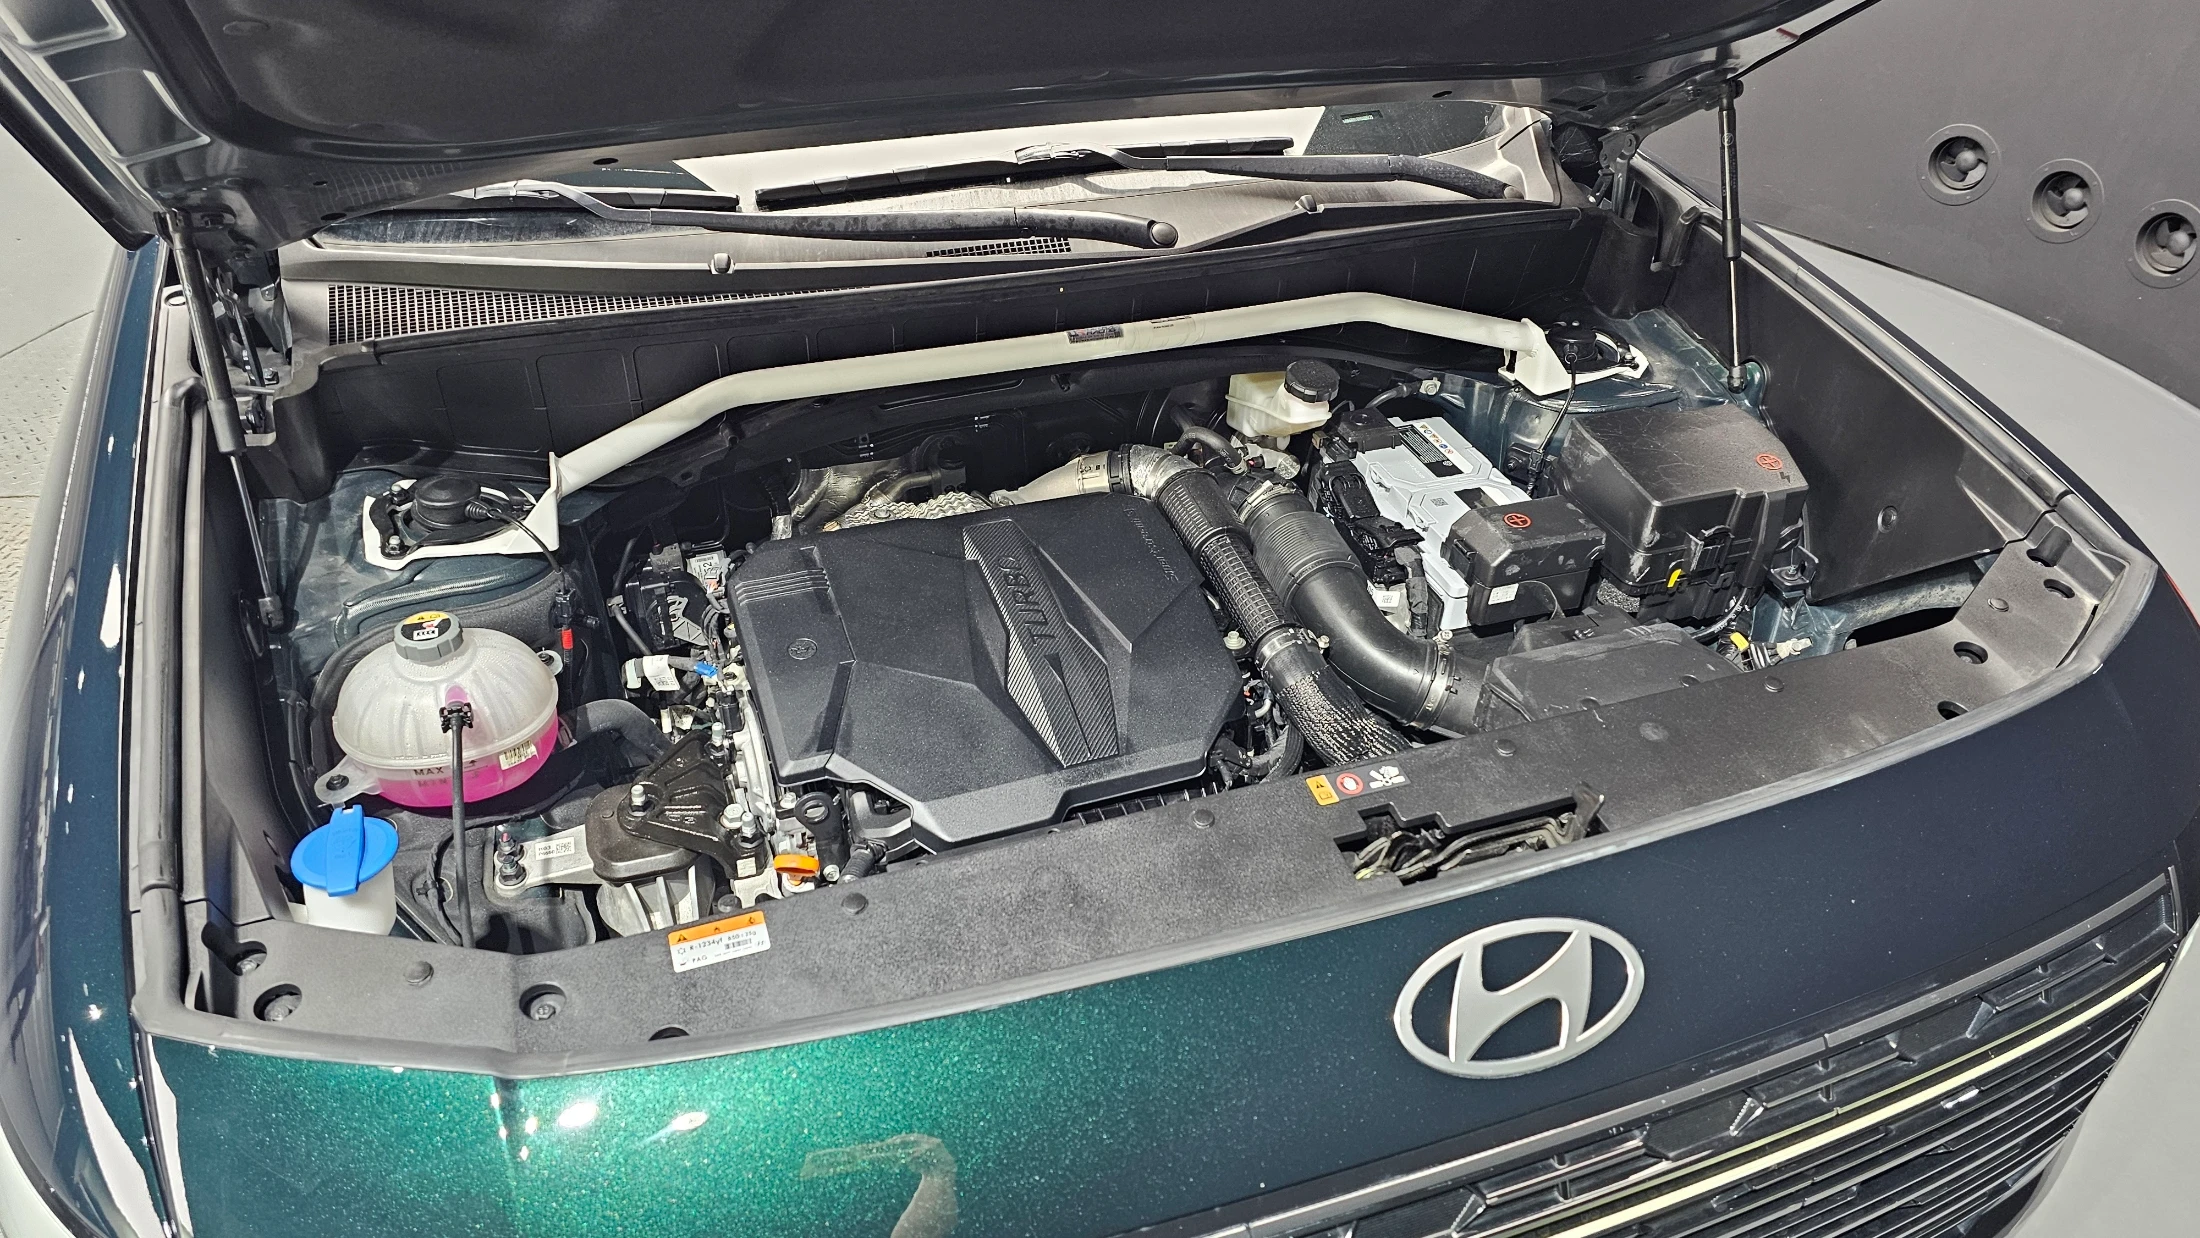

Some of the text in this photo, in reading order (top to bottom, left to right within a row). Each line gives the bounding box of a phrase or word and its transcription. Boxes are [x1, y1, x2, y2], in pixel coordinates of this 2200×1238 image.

[998, 555, 1058, 647] TURBO
[413, 766, 444, 776] MAX
[689, 938, 723, 950] R-1234yf
[692, 955, 708, 963] PAG
